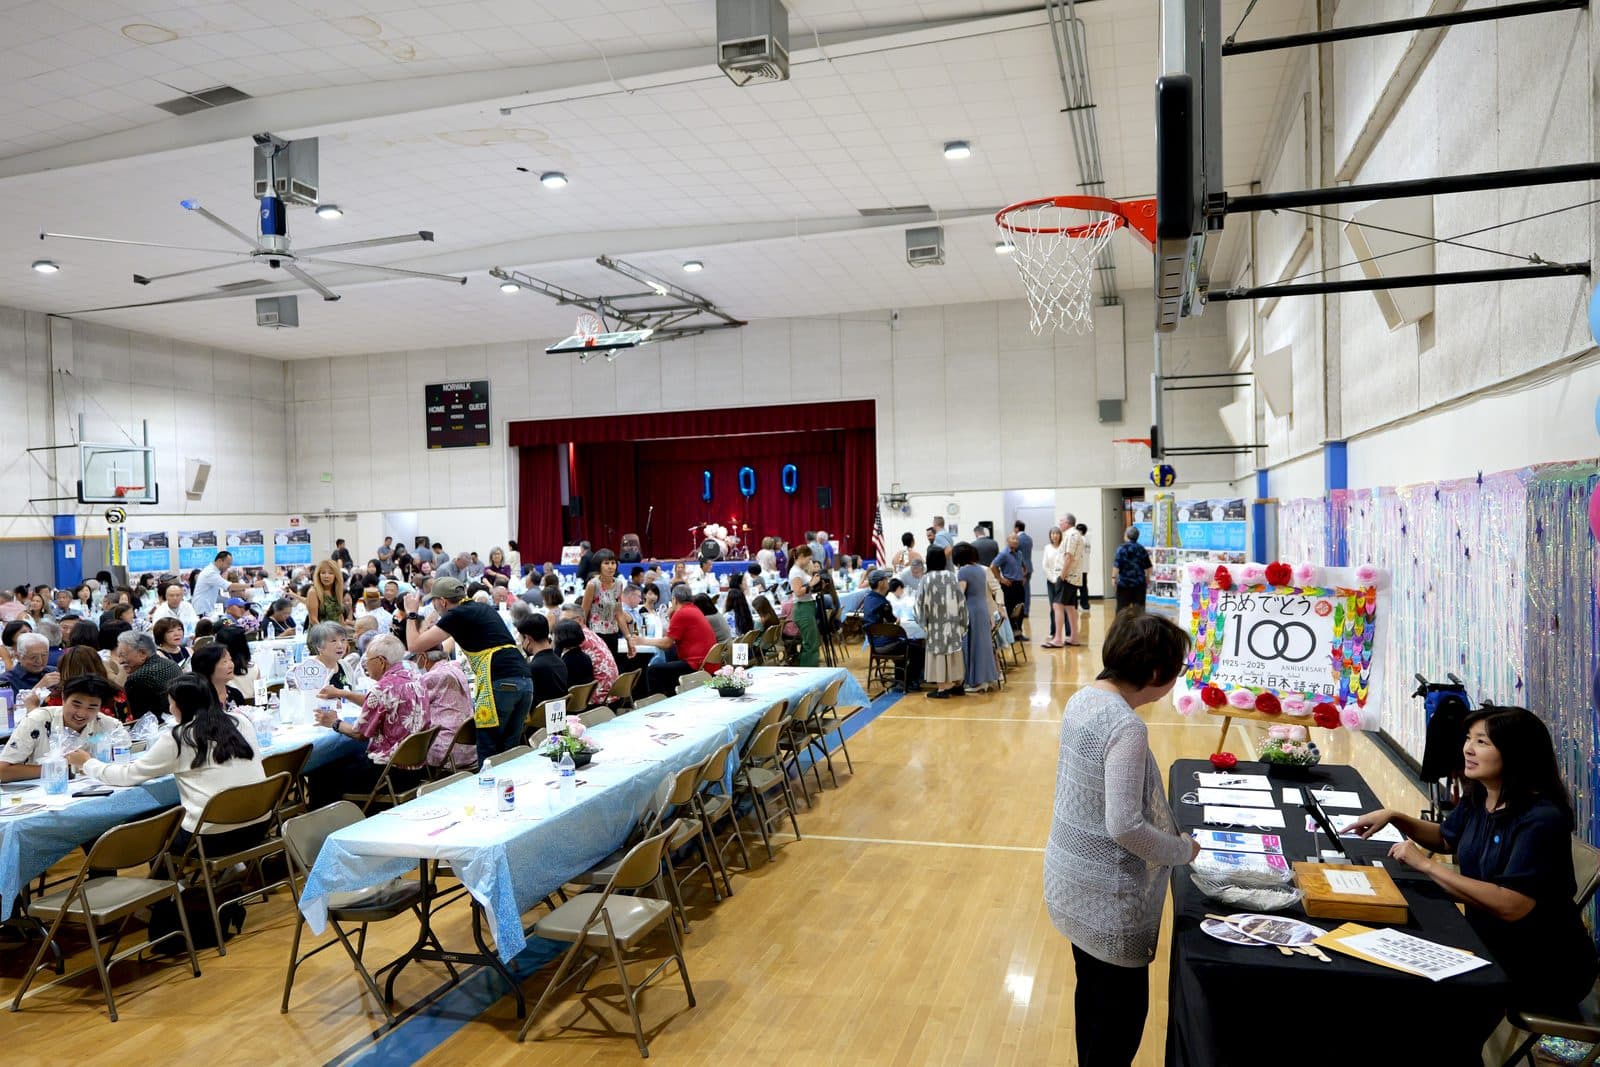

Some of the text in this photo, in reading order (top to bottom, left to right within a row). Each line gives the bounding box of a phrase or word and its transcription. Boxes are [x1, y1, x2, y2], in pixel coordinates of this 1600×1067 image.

[442, 382, 471, 392] NORWALK
[428, 405, 445, 414] HOME
[468, 402, 487, 411] GUEST
[1219, 592, 1312, 616] おめでとう
[1232, 614, 1317, 663] 100
[303, 666, 320, 676] 100
[1281, 665, 1327, 673] ANNIVERSARY
[551, 711, 563, 723] 44
